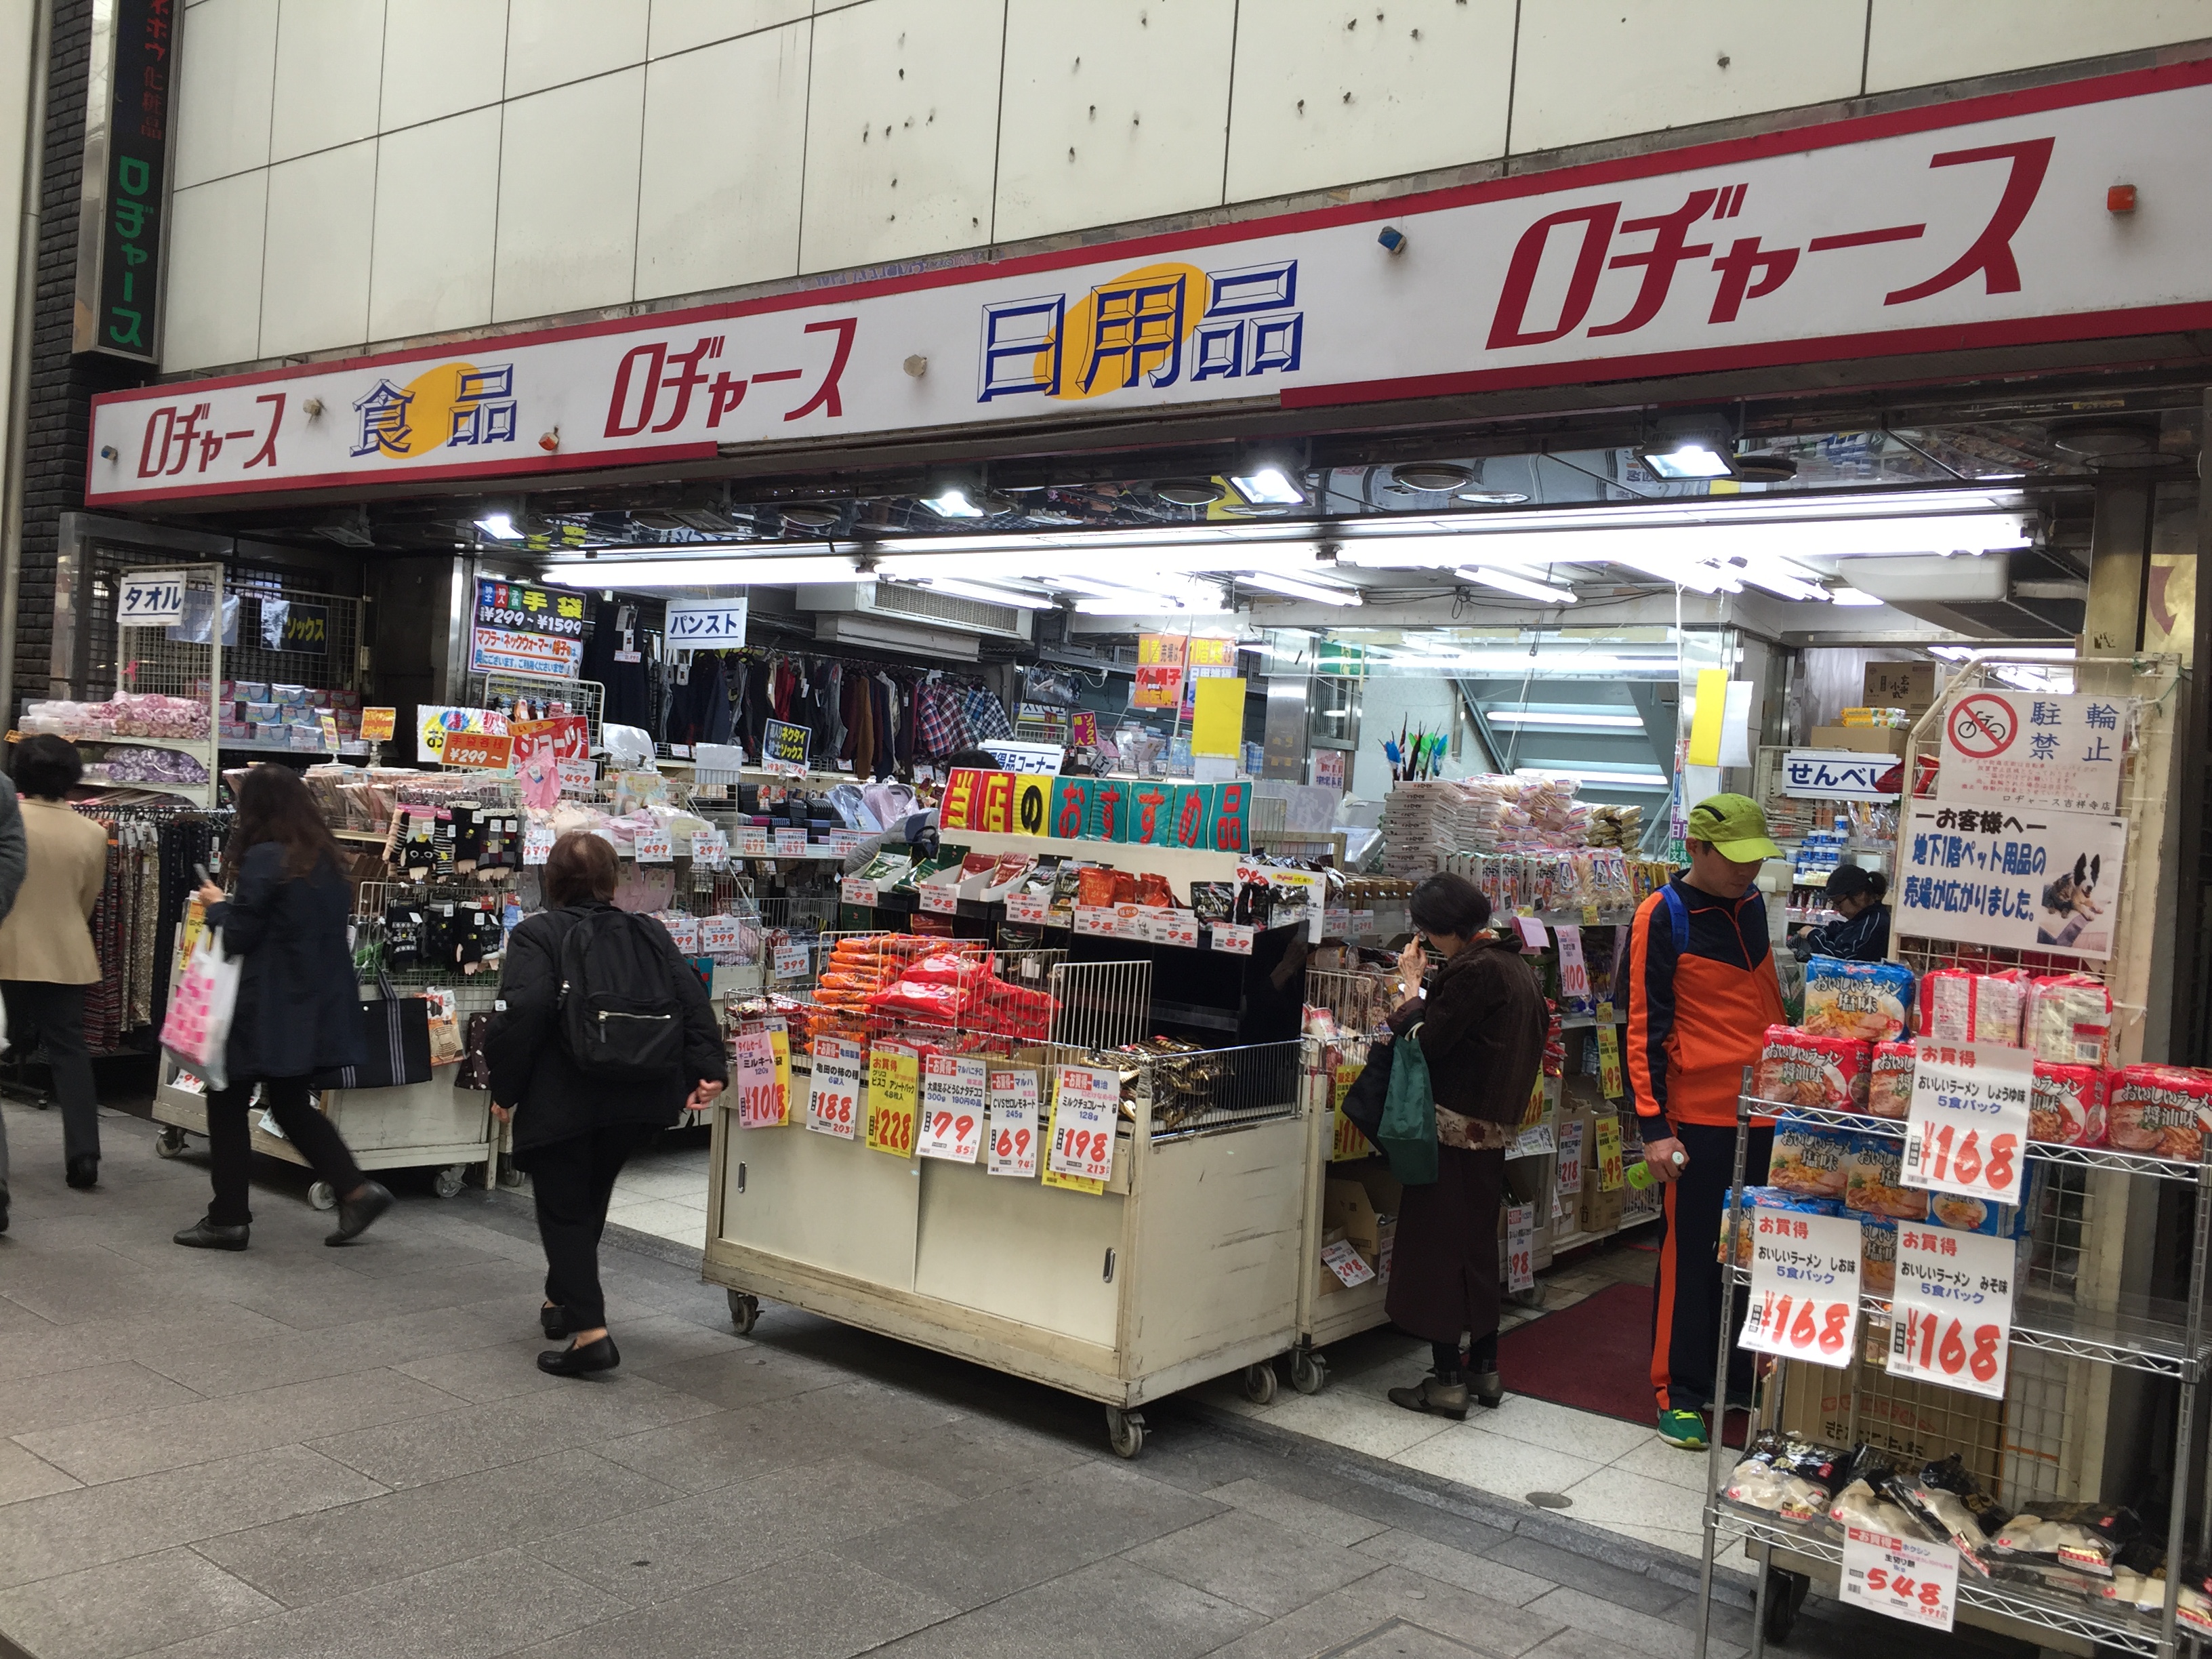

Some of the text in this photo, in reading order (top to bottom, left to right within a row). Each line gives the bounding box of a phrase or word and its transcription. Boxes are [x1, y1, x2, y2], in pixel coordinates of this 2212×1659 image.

[110, 155, 155, 348] ロヂャース
[1486, 136, 2056, 350] ロヂャース
[977, 259, 1303, 404] 日用品
[604, 316, 858, 438] ロヂャース
[350, 363, 517, 458] 食品
[137, 392, 287, 478] ロヂャース
[124, 586, 182, 611] タオル
[523, 591, 583, 619] 手袋
[670, 612, 737, 636] パンスト
[2030, 701, 2120, 731] 駐輪
[1084, 714, 1096, 745] ソックス
[2029, 733, 2113, 762] 禁止
[564, 773, 591, 785] 499
[947, 771, 1242, 850] 当店のおすすめ品
[2003, 795, 2111, 811] ロヂャース吉祥寺店
[1912, 833, 2047, 876] 地下1階ペット用品の
[854, 892, 874, 901] 98
[933, 899, 954, 908] 98
[1904, 875, 2034, 922] 売場が広がりました。
[1020, 909, 1042, 918] 98
[1089, 920, 1113, 930] 98
[1168, 930, 1193, 941] 98
[712, 933, 735, 943] 399
[1225, 938, 1250, 948] 89
[783, 958, 806, 970] 399
[1814, 974, 1902, 997] おいしいラーメン
[1837, 994, 1879, 1014] 塩味
[738, 1038, 762, 1051] タイムセール
[1767, 1042, 1844, 1066] おいしいラーメン
[872, 1057, 898, 1072] お買得
[1921, 1046, 1977, 1068] お買得
[816, 1063, 859, 1080] 亀田の柿の種
[828, 1077, 845, 1086] 6袋入
[872, 1069, 886, 1078] グリコ
[957, 1065, 983, 1076] マルハニチロ
[1782, 1061, 1824, 1083] 醤油味
[872, 1077, 886, 1087] ビスコ
[889, 1080, 915, 1094] アソートパック
[928, 1081, 983, 1098] 大満足ぶどう&ナタデココ
[1015, 1078, 1033, 1087] マルハ
[1093, 1079, 1108, 1090] 明治
[1918, 1076, 2026, 1104] おいしいラーメン しょうゆ味
[884, 1090, 904, 1101] 48枚入
[927, 1092, 982, 1107] 300g 190円の品
[993, 1098, 1036, 1109] CVSゼロレモネード
[1062, 1096, 1107, 1113] ミルクチョコレート
[1938, 1095, 2001, 1114] 5食パック
[2122, 1082, 2212, 1110] おいしいラーメ
[817, 1092, 853, 1123] 188
[1006, 1110, 1023, 1118] 245g
[1080, 1111, 1099, 1122] 128g
[2143, 1105, 2199, 1130] 醤油味
[834, 1123, 851, 1134] 203
[874, 1105, 912, 1150] ¥228
[933, 1110, 974, 1143] 79
[956, 1145, 970, 1155] 85
[996, 1128, 1031, 1158] 69
[1064, 1128, 1108, 1162] 198
[1017, 1160, 1029, 1168] 74
[1800, 1149, 1839, 1172] 塩味
[1921, 1120, 2018, 1191] ¥168
[1087, 1164, 1106, 1174] 213
[1561, 1160, 1578, 1183] 218
[1759, 1216, 1809, 1240] お買得
[1902, 1231, 1958, 1256] お買得
[1338, 1258, 1364, 1277] 298
[1512, 1251, 1529, 1276] 98
[1759, 1246, 1856, 1274] おいしいラーメン しお味
[1777, 1266, 1835, 1284] 5食パック
[1902, 1261, 2008, 1294] おいしいラーメン みそ味
[1921, 1283, 1984, 1304] 5食パック
[1760, 1290, 1850, 1355] ¥168
[1906, 1307, 2001, 1382] ¥168
[1858, 1531, 1930, 1556] お買得 ホクシン
[1885, 1554, 1915, 1568] 生切り餅
[1867, 1568, 1942, 1606] 548
